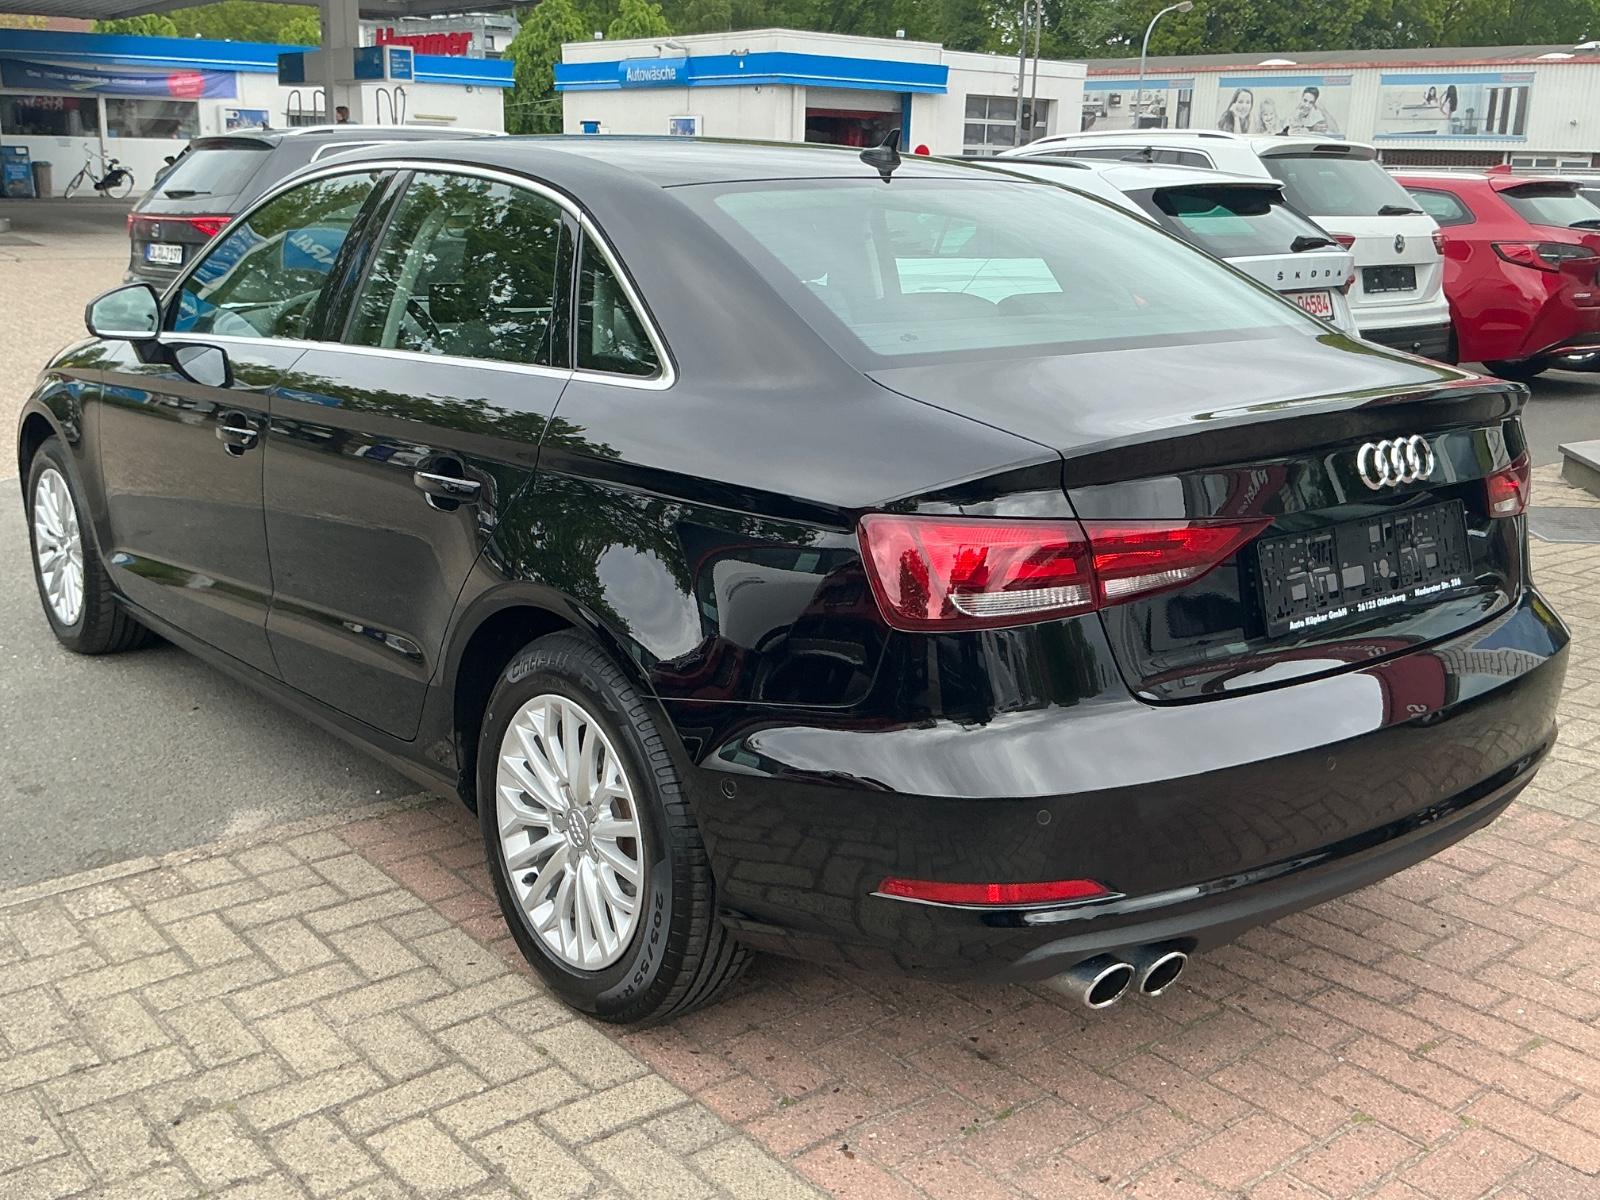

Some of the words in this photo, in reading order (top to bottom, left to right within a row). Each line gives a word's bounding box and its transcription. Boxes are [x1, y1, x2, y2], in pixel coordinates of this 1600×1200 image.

[626, 65, 677, 82] Autowäsche
[1277, 269, 1342, 281] ŠKODA
[1289, 620, 1304, 630] Auto
[1305, 613, 1328, 629] Küpker
[1328, 607, 1348, 620] GmbH
[1377, 593, 1407, 607] Oldenburg
[633, 889, 664, 986] 205/55
